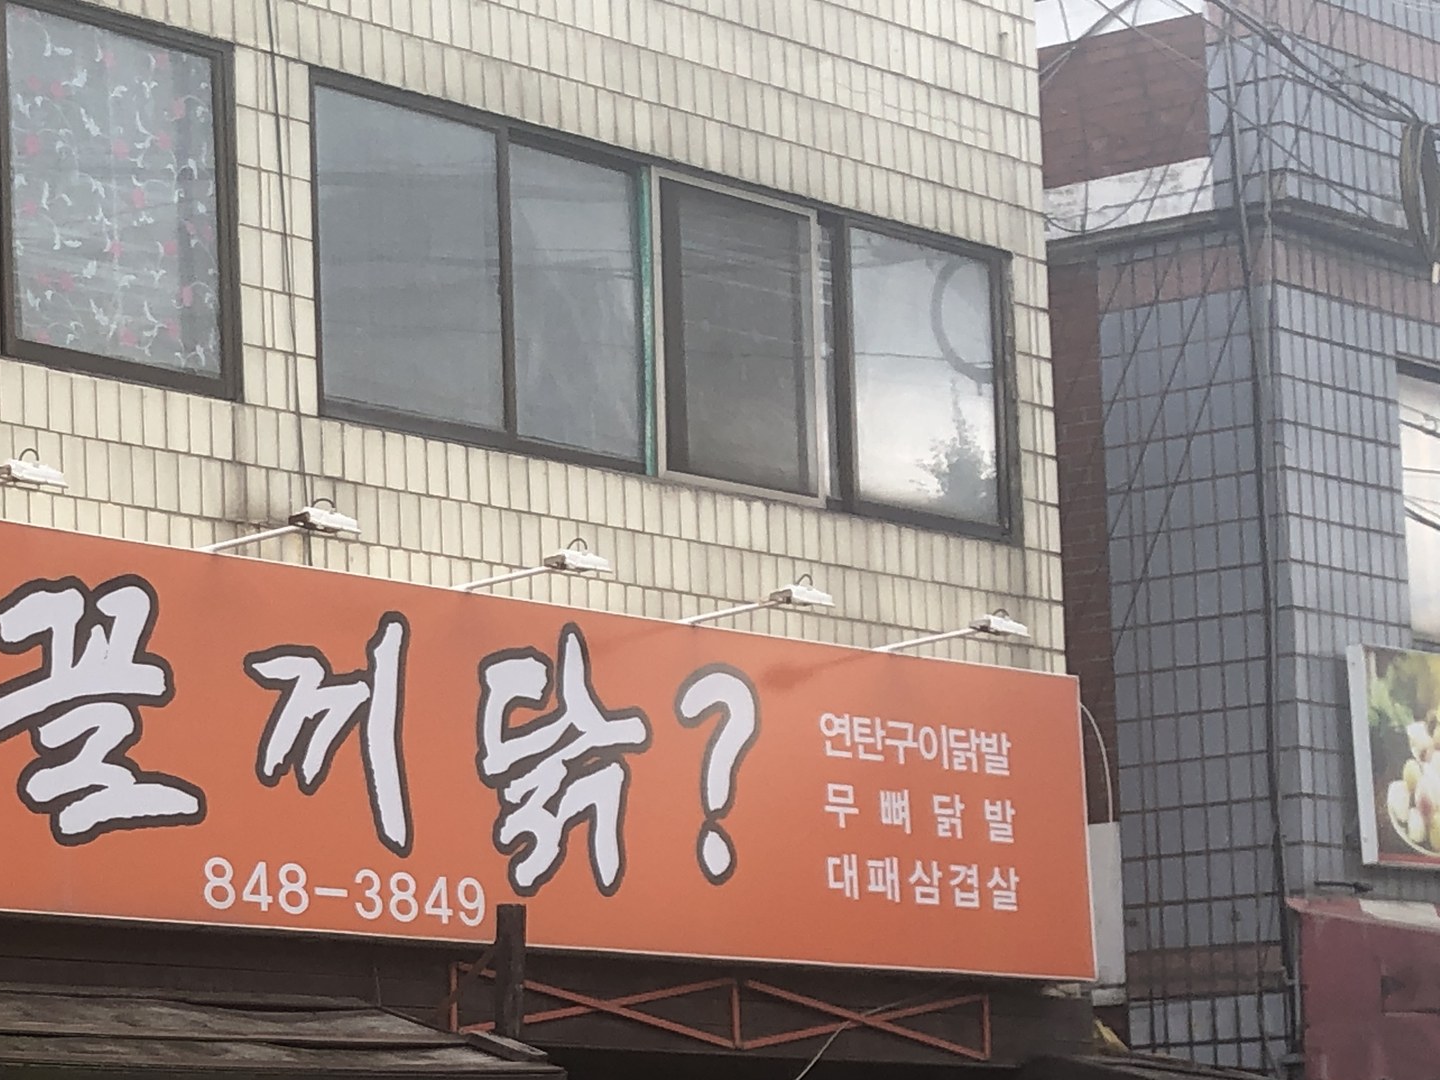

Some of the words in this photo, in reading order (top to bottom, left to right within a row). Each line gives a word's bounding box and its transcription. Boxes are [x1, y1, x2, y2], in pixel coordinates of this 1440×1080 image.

[819, 712, 1012, 776] 연탄구이닭발
[203, 857, 486, 928] 848-3849
[826, 853, 1020, 912] 대패삼겹살
